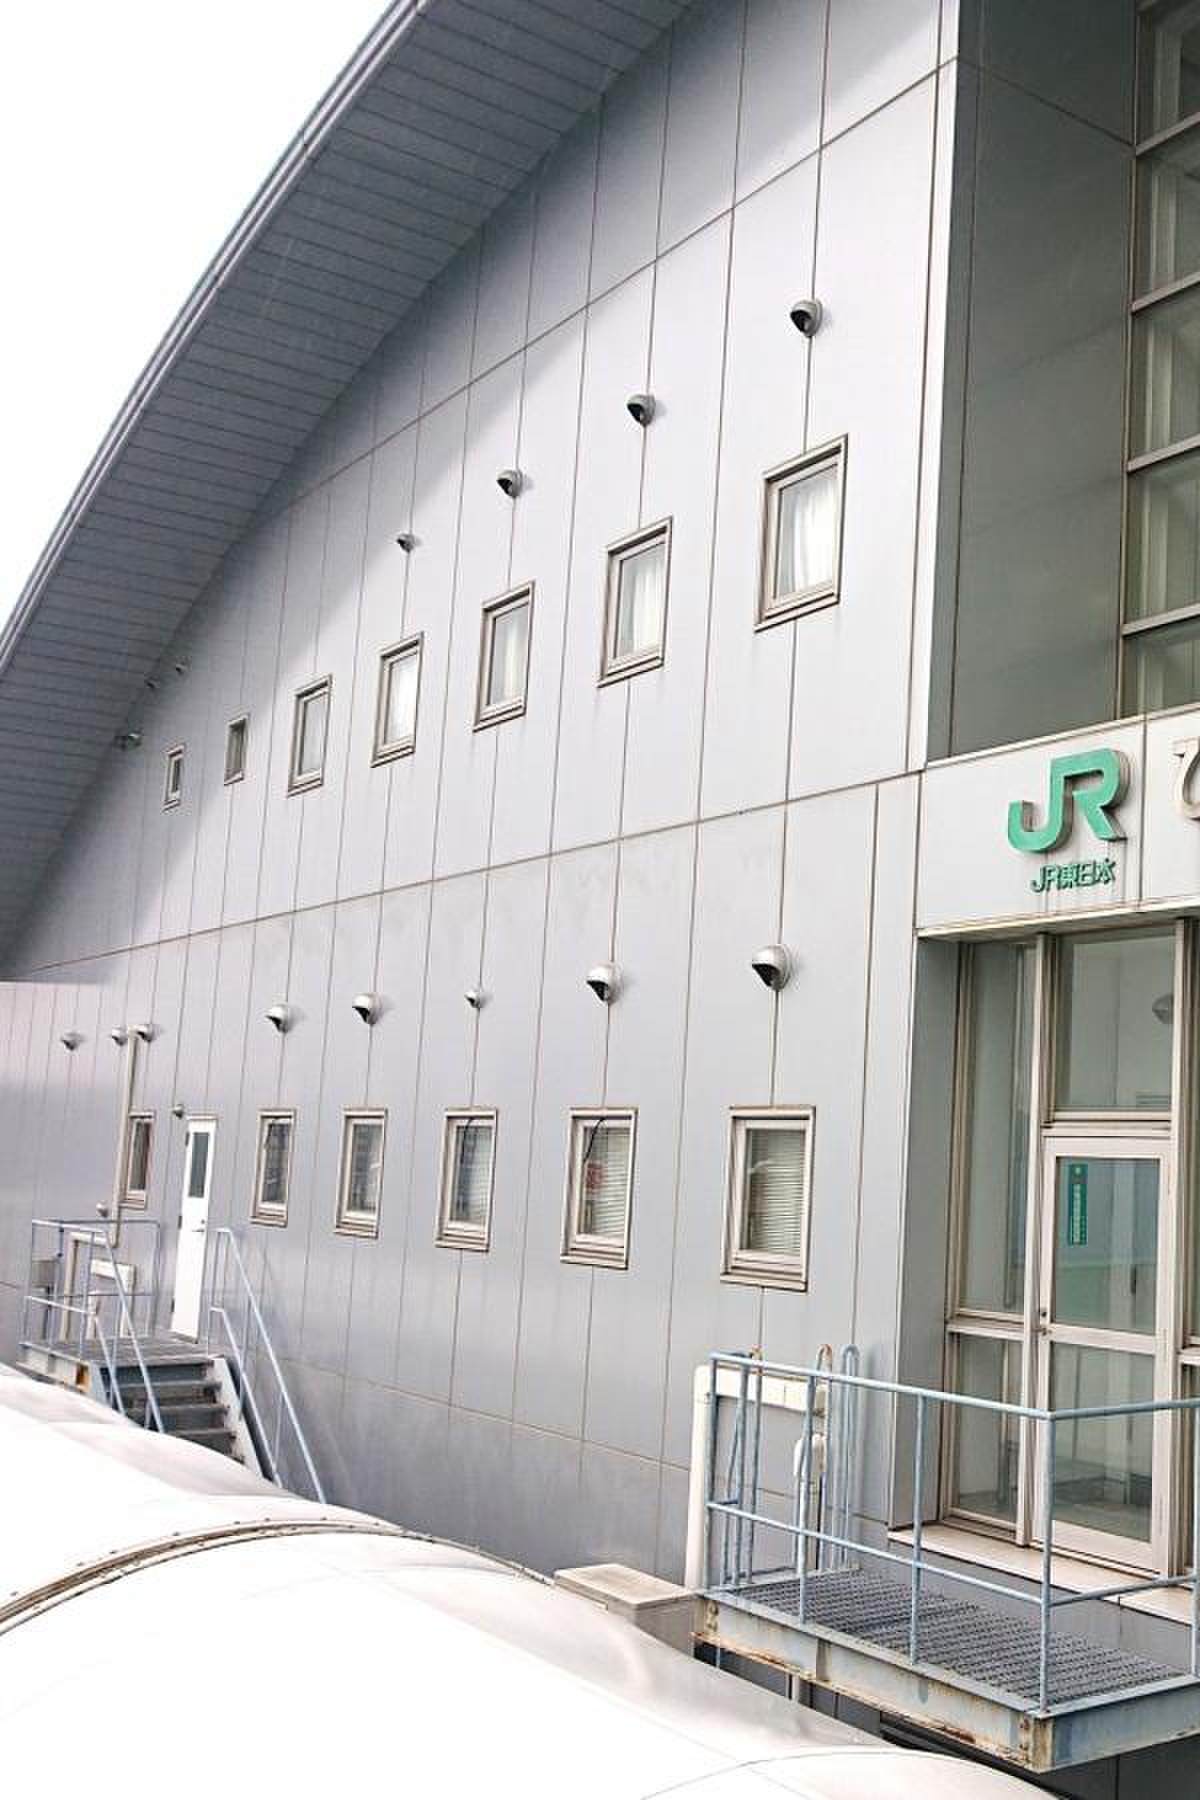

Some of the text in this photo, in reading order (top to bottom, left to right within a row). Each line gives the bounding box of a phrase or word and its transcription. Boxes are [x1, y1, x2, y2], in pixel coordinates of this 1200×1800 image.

[1008, 748, 1129, 853] JR
[1031, 858, 1117, 892] JR東日本
